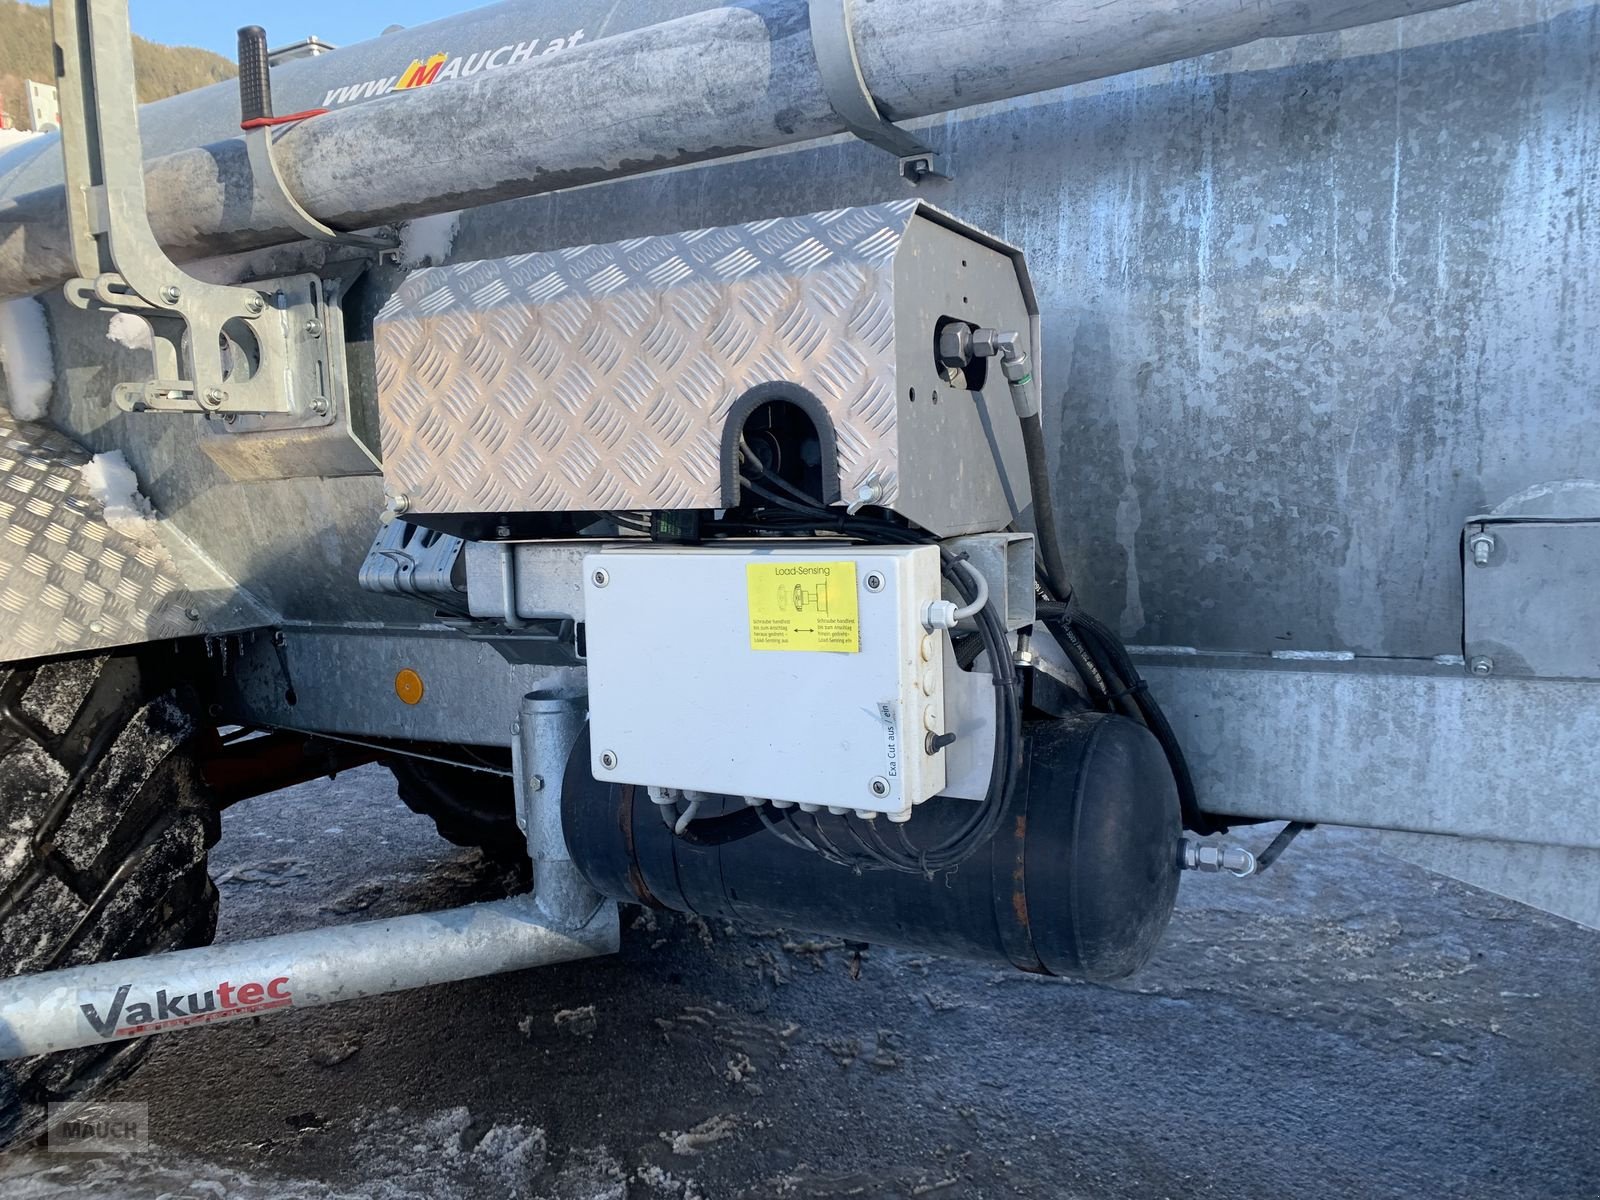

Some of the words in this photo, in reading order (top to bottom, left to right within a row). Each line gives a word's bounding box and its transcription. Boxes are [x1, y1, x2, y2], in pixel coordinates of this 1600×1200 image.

[775, 566, 830, 576] Load-Sensing
[882, 706, 890, 718] ein
[889, 762, 897, 777] Exa
[80, 976, 292, 1038] Vakutec
